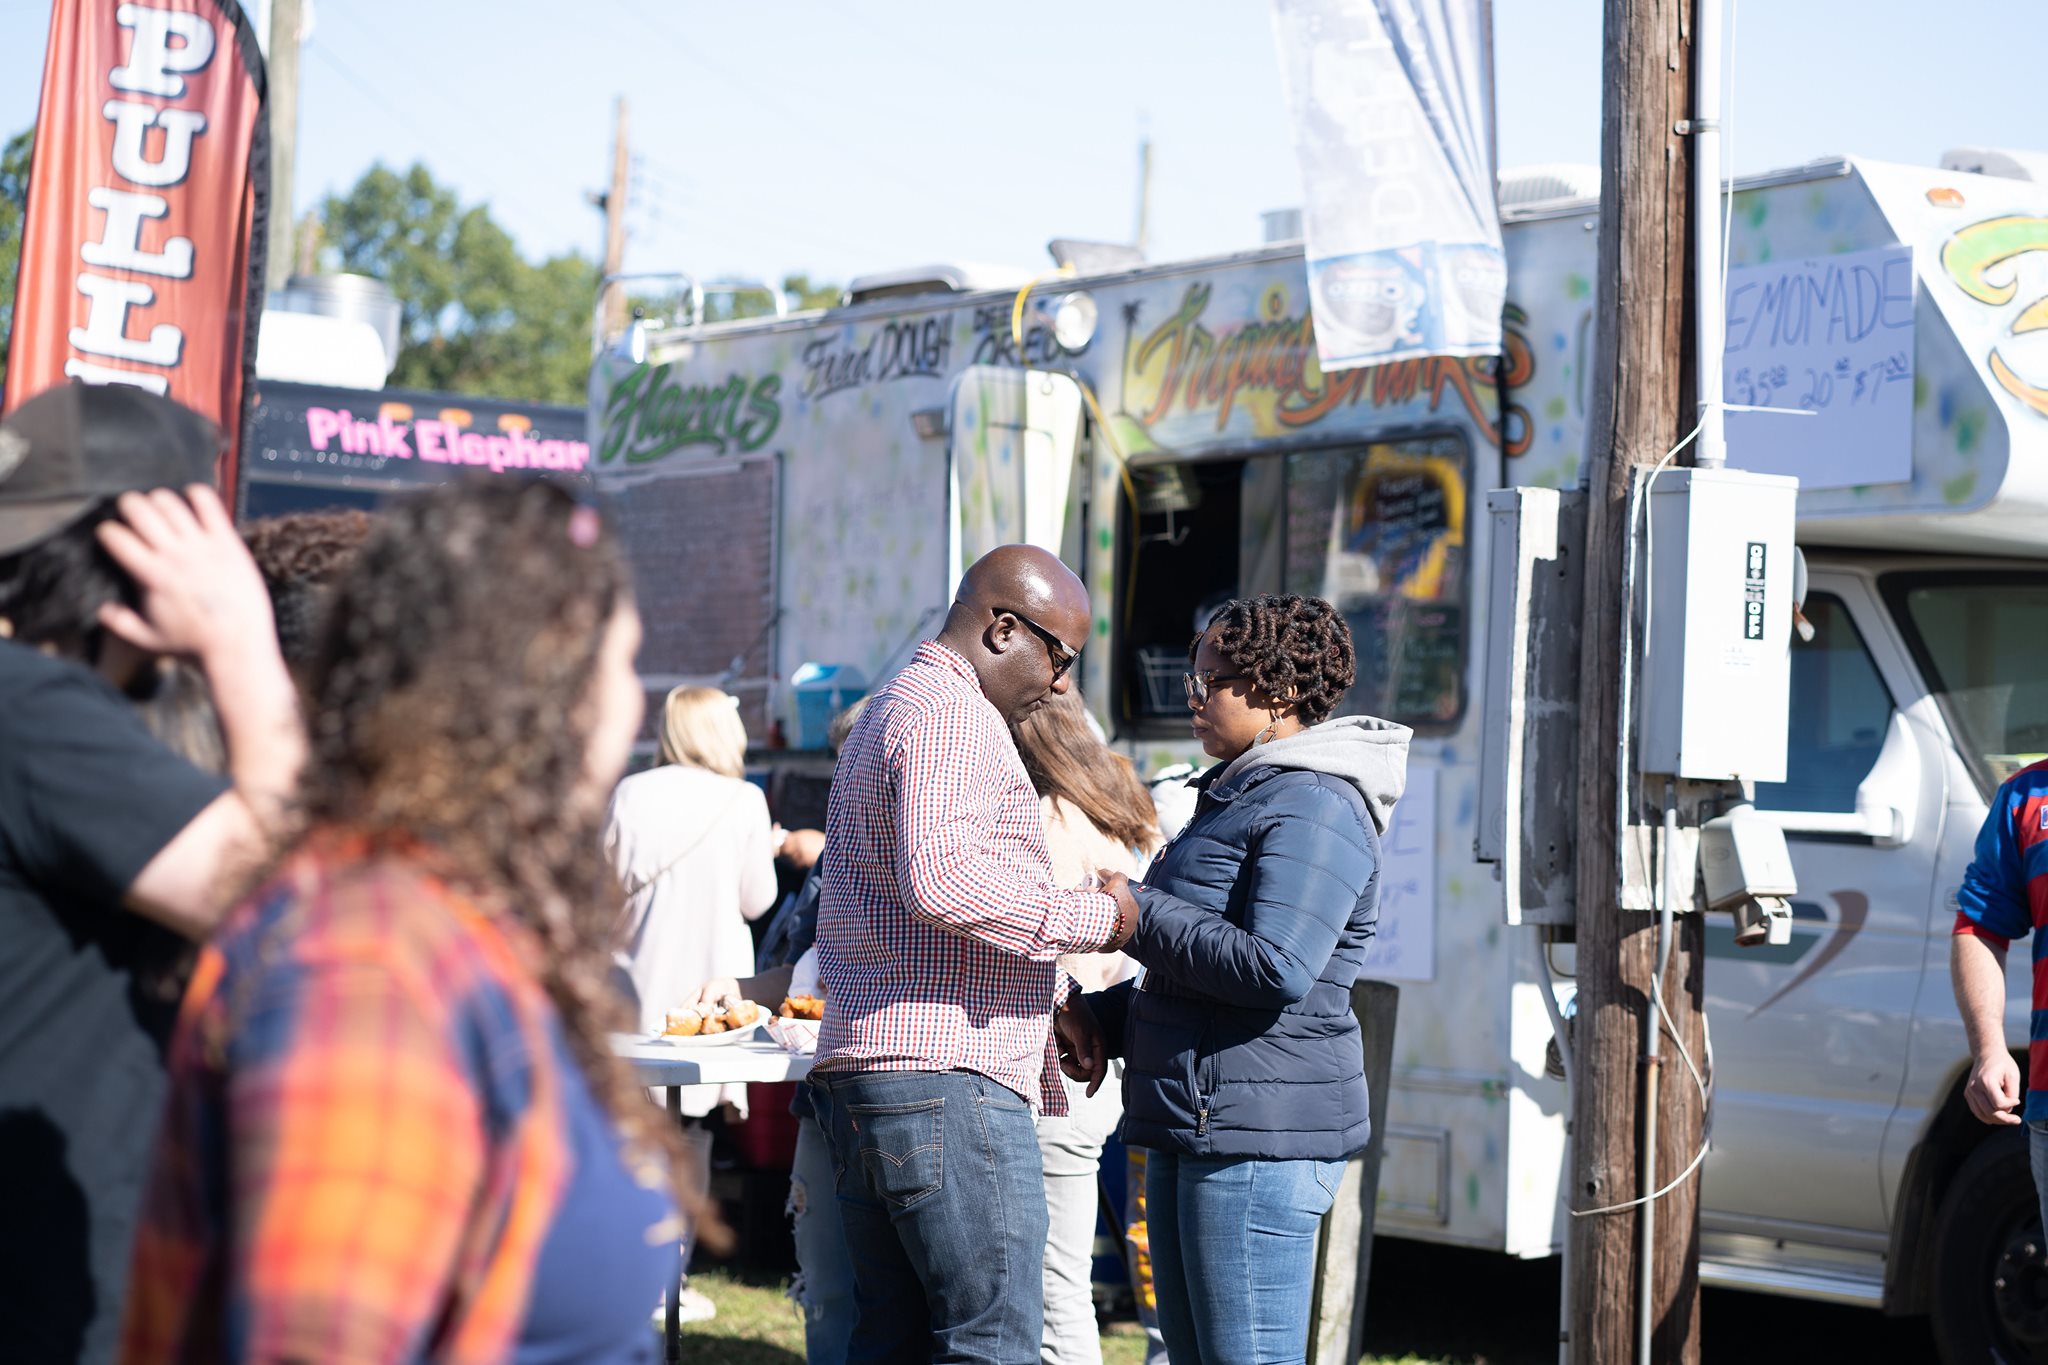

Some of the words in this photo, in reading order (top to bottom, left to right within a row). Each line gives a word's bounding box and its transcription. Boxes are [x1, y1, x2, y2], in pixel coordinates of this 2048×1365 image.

[64, 3, 217, 397] PULL
[1724, 255, 1914, 354] EMONADE
[306, 406, 412, 459] Pink
[1749, 545, 1763, 570] ON
[1748, 602, 1761, 638] OFF
